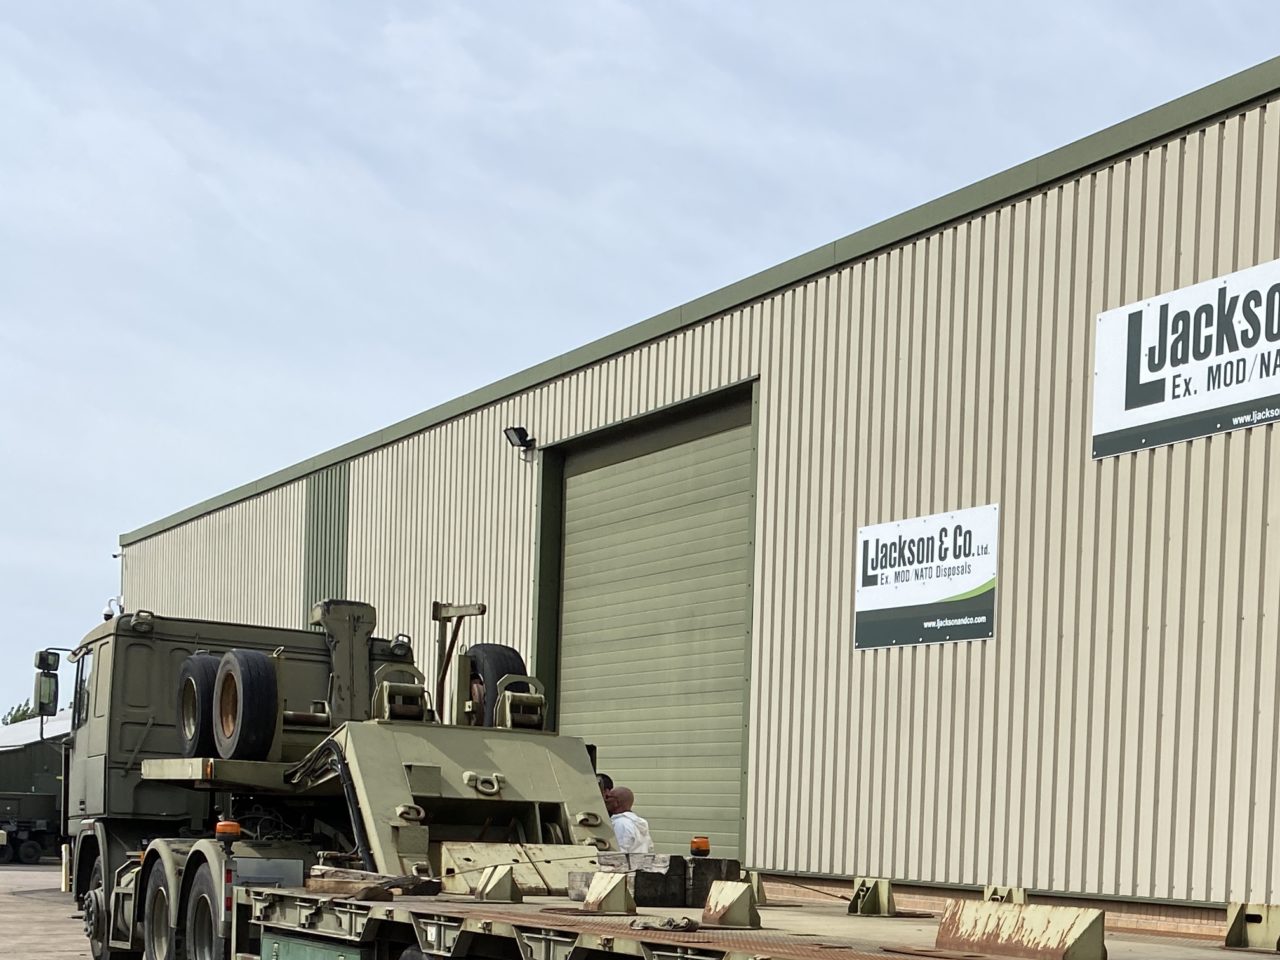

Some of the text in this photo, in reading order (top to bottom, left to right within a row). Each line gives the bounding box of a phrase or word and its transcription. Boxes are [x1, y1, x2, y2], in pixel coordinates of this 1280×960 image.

[1171, 373, 1198, 400] Ex.
[938, 527, 949, 562] &
[952, 524, 975, 560] Co.
[976, 544, 991, 556] Ltd.
[880, 572, 891, 586] Ex.
[936, 561, 972, 578] Disposals
